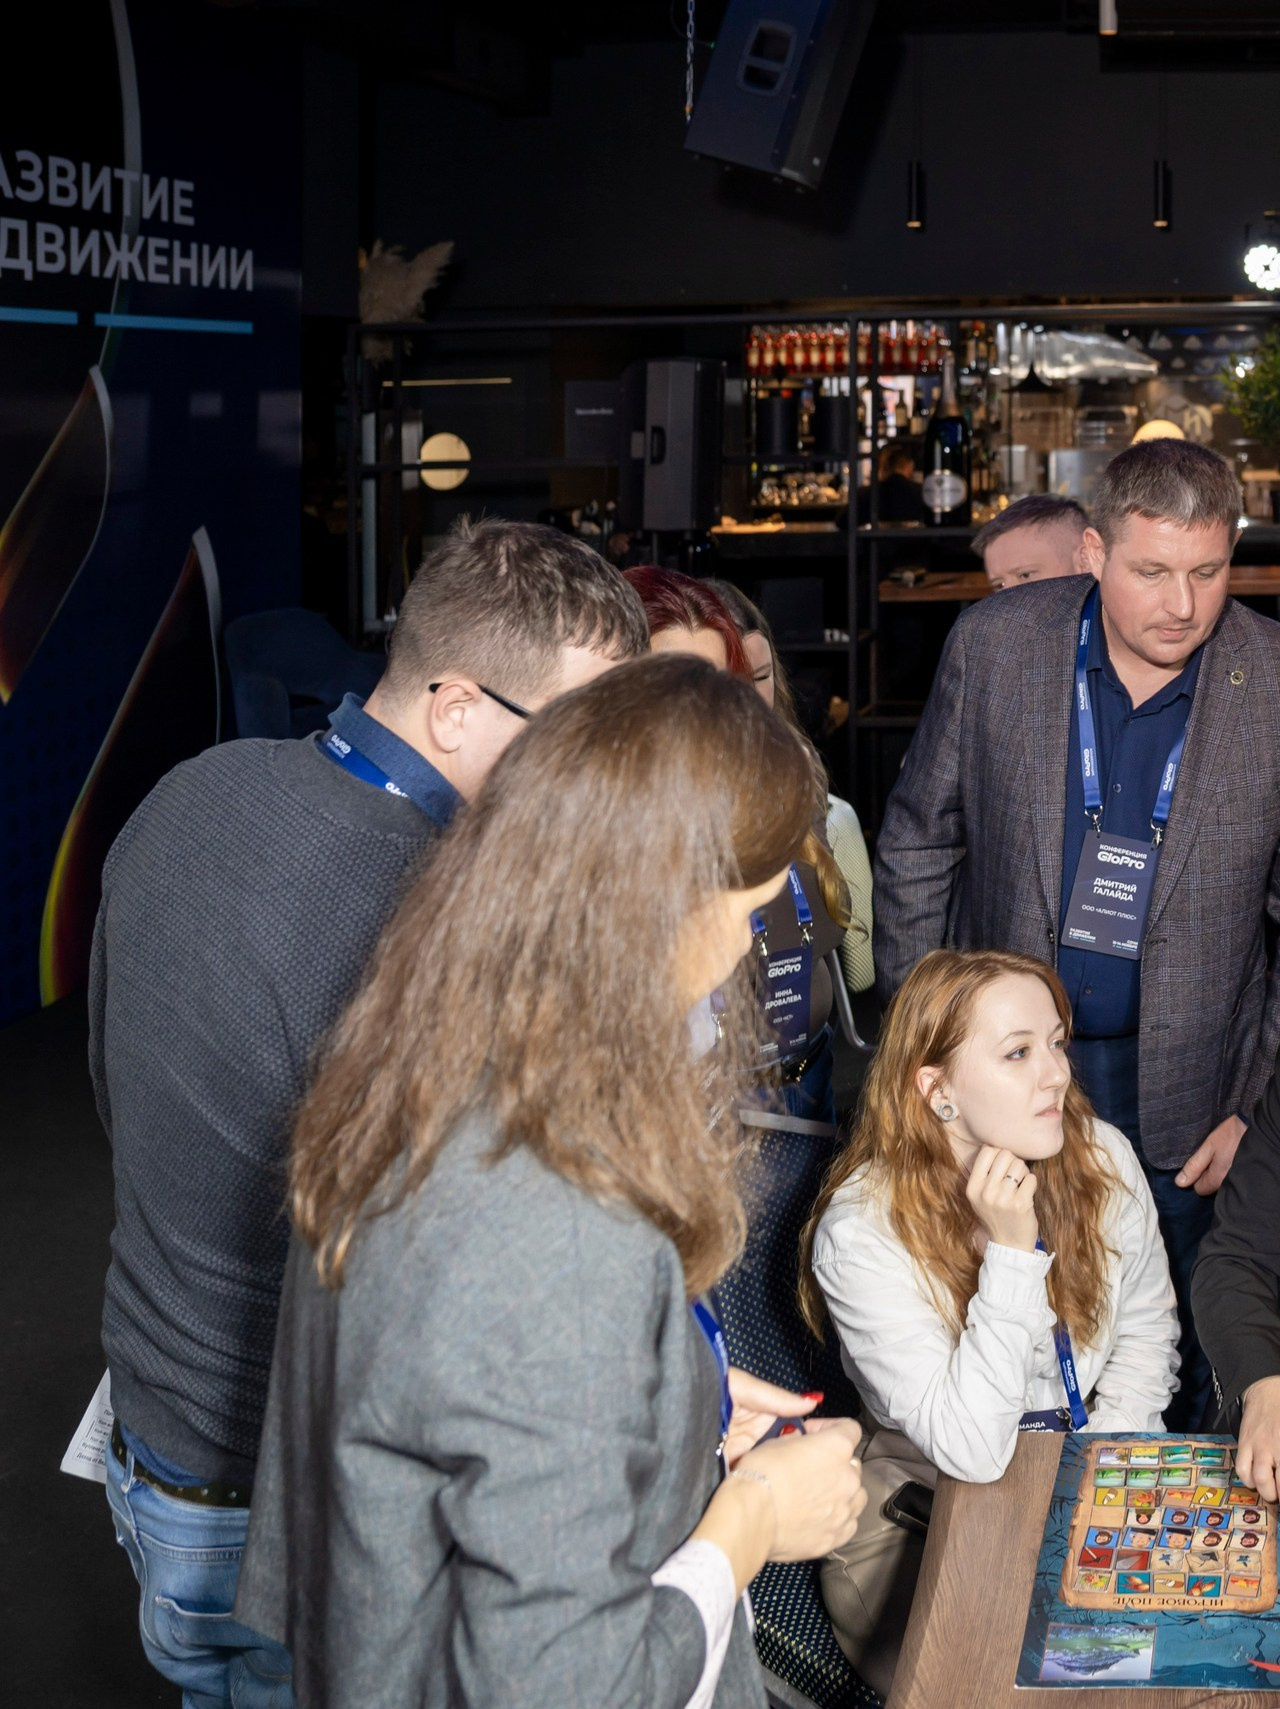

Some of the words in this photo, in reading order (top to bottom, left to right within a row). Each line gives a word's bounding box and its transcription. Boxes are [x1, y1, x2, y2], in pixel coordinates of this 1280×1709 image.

[0, 216, 254, 291] ДВИЖЕНИИ
[1162, 762, 1174, 791] GloPro
[1099, 843, 1148, 860] КОНФЕРЕНЦИЯ
[1097, 851, 1145, 870] GloPro
[1093, 877, 1137, 893] ДМИТРИЙ
[1093, 886, 1134, 902] ГАЛАЙДА
[1081, 904, 1095, 912] ООО
[767, 963, 802, 978] GloPro
[1066, 1359, 1076, 1392] GloPro
[1019, 1421, 1046, 1429] МАНДА
[1112, 1596, 1152, 1606] ПОЛЕ
[1156, 1597, 1224, 1607] ИГРОВОЕ
